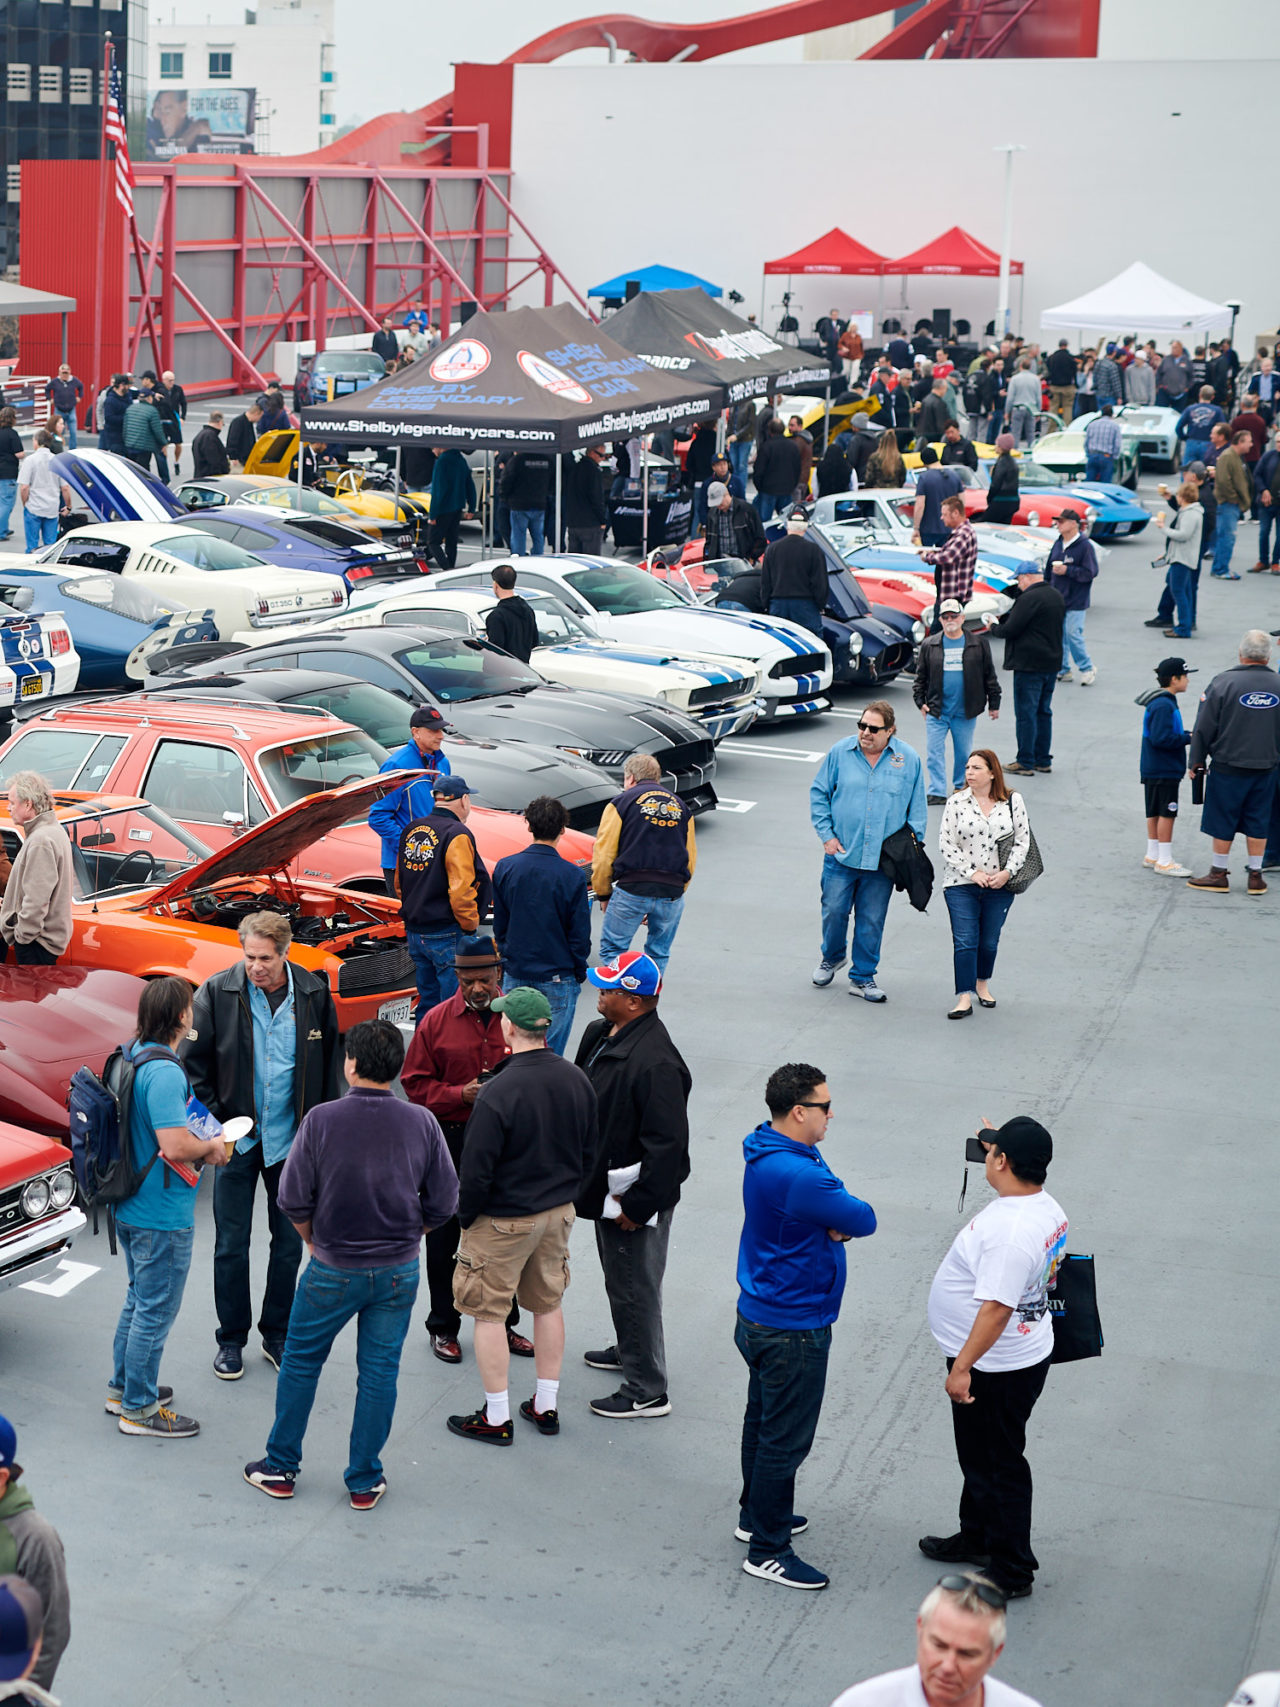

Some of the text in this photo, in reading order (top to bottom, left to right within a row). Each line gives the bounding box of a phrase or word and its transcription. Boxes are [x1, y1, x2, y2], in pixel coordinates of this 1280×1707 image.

[543, 342, 608, 367] SHELBY
[377, 384, 477, 396] SHELBY
[370, 394, 524, 406] LEGENDARY
[366, 403, 437, 411] CARS
[577, 398, 711, 440] www.Shelbylegendarycars.com
[304, 419, 556, 441] www.Shelbylegendarycars.com
[1245, 693, 1273, 706] Ford
